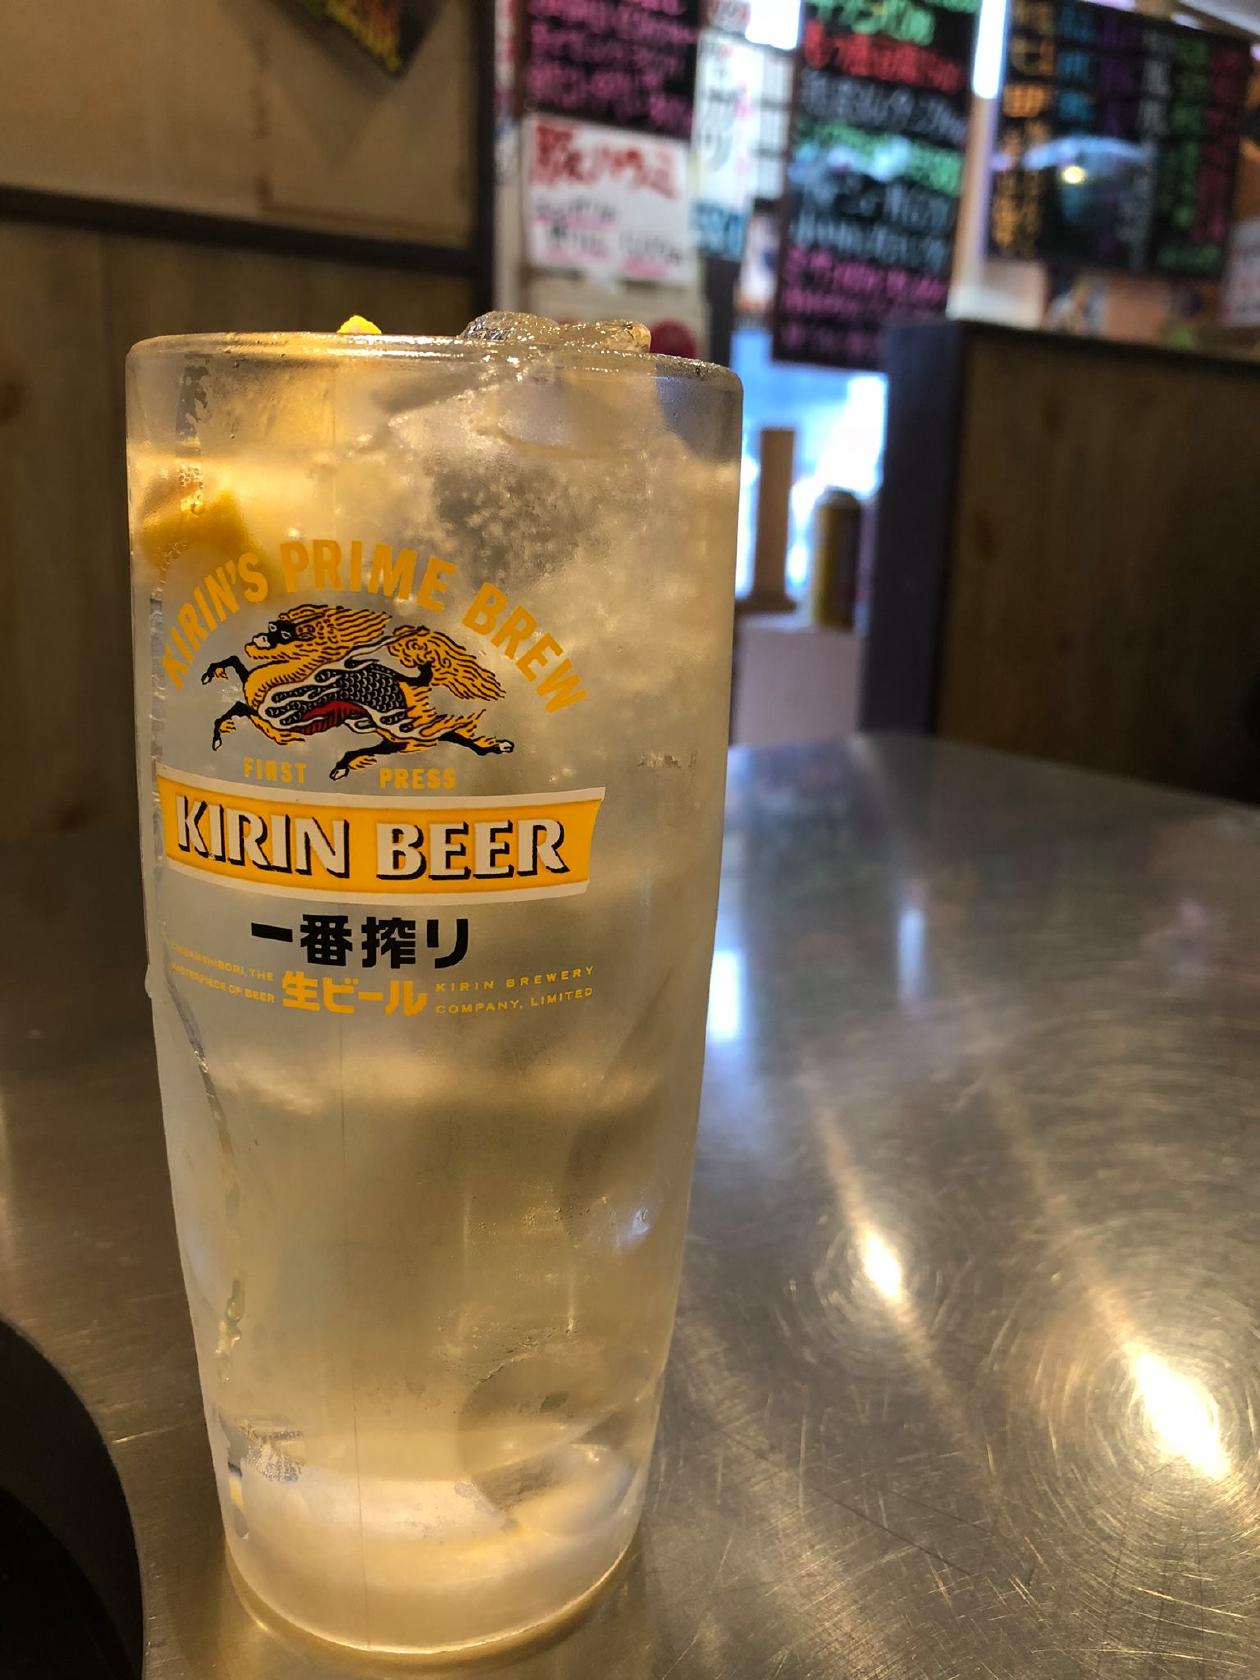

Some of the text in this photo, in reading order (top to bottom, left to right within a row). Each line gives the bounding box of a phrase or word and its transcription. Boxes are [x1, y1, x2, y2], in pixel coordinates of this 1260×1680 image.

[161, 539, 589, 715] KIRIN'S PRIME BREW
[243, 757, 457, 791] FIRST PRESS
[175, 794, 571, 882] KIRIN BEER
[250, 914, 470, 969] 一番搾り
[250, 967, 274, 982] THE
[435, 965, 594, 993] KIRIN BREWERY
[243, 987, 276, 1003] BEER
[281, 970, 428, 1017] 生ビール
[530, 987, 593, 1008] LIMITED
